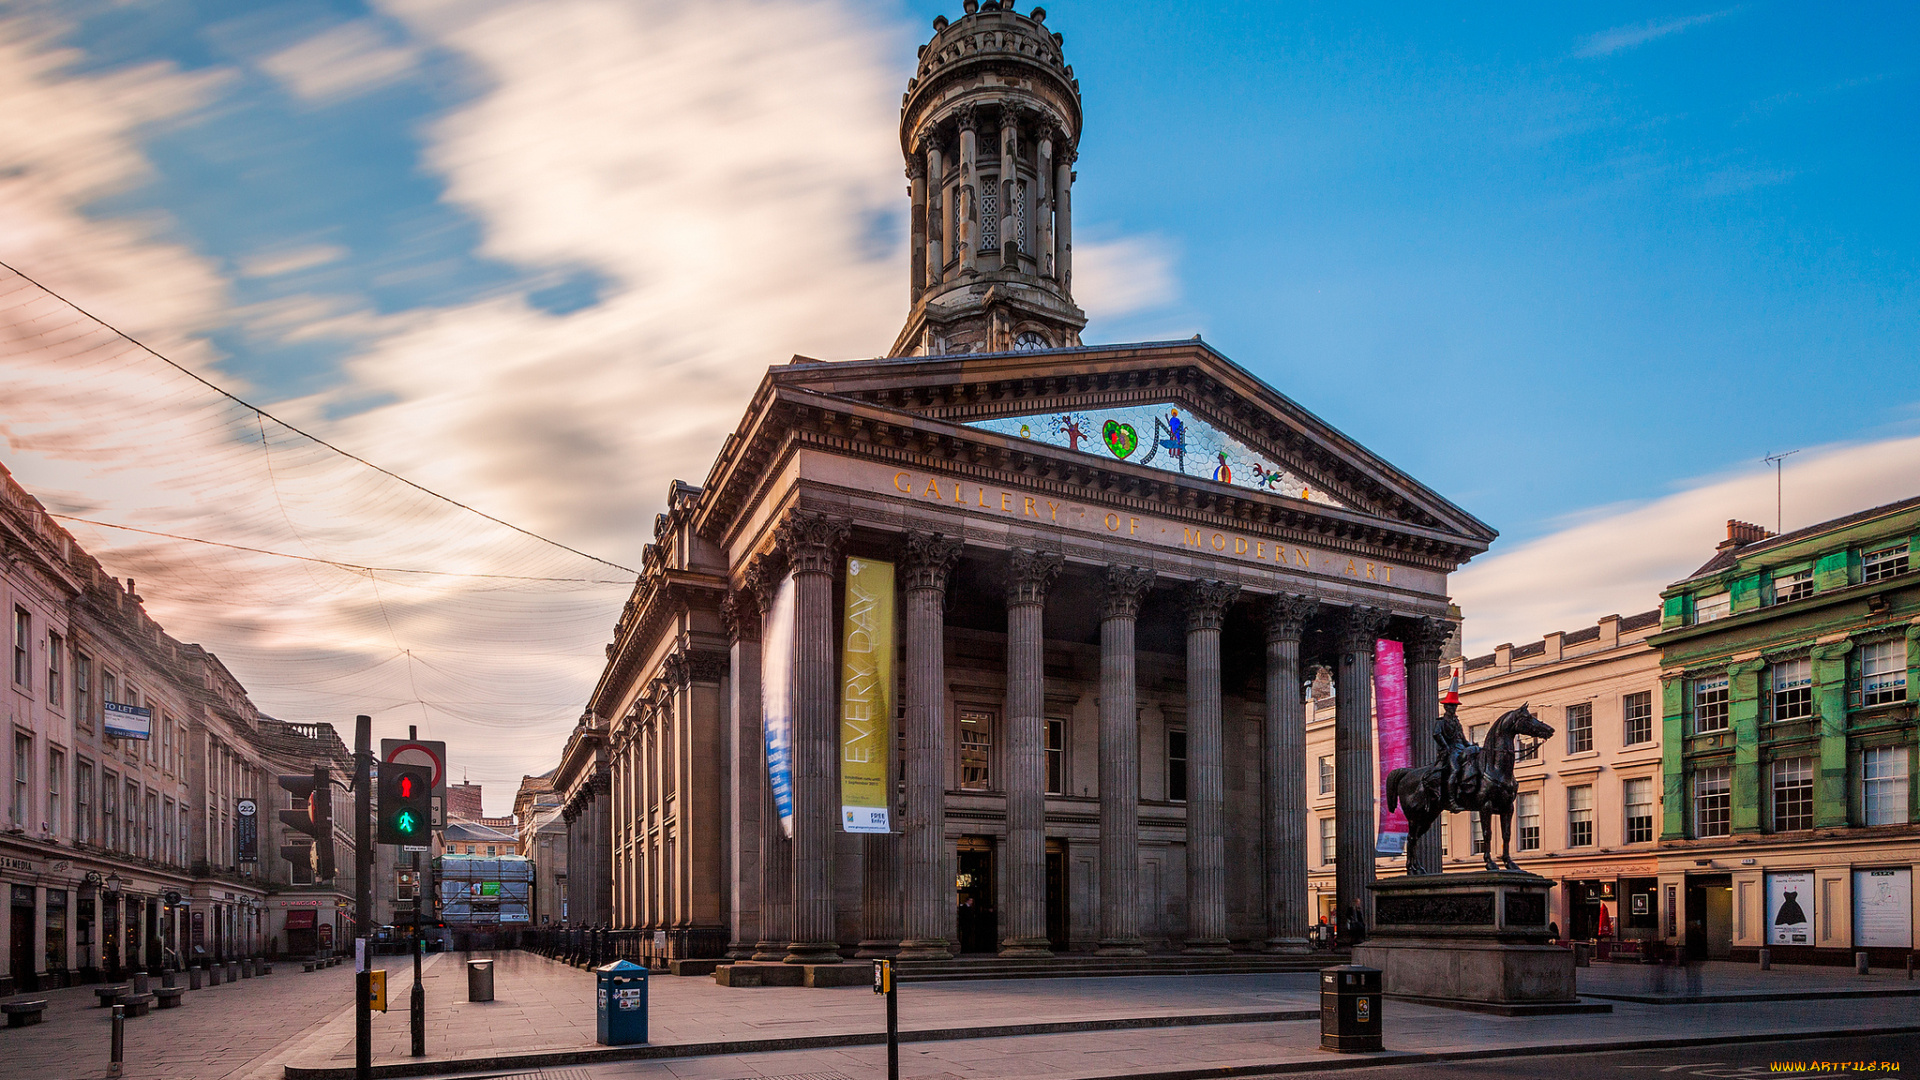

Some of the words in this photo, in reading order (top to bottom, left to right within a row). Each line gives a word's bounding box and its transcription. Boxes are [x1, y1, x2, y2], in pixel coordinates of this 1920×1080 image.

[894, 472, 1060, 521] GALLERY
[1105, 513, 1141, 535] OF
[1183, 527, 1310, 567] MODERN
[1345, 559, 1394, 582] ART
[847, 584, 876, 653] DAY
[105, 702, 116, 710] TO
[118, 705, 133, 713] LET
[845, 659, 877, 763] EVERY
[12, 860, 31, 870] MEDIA
